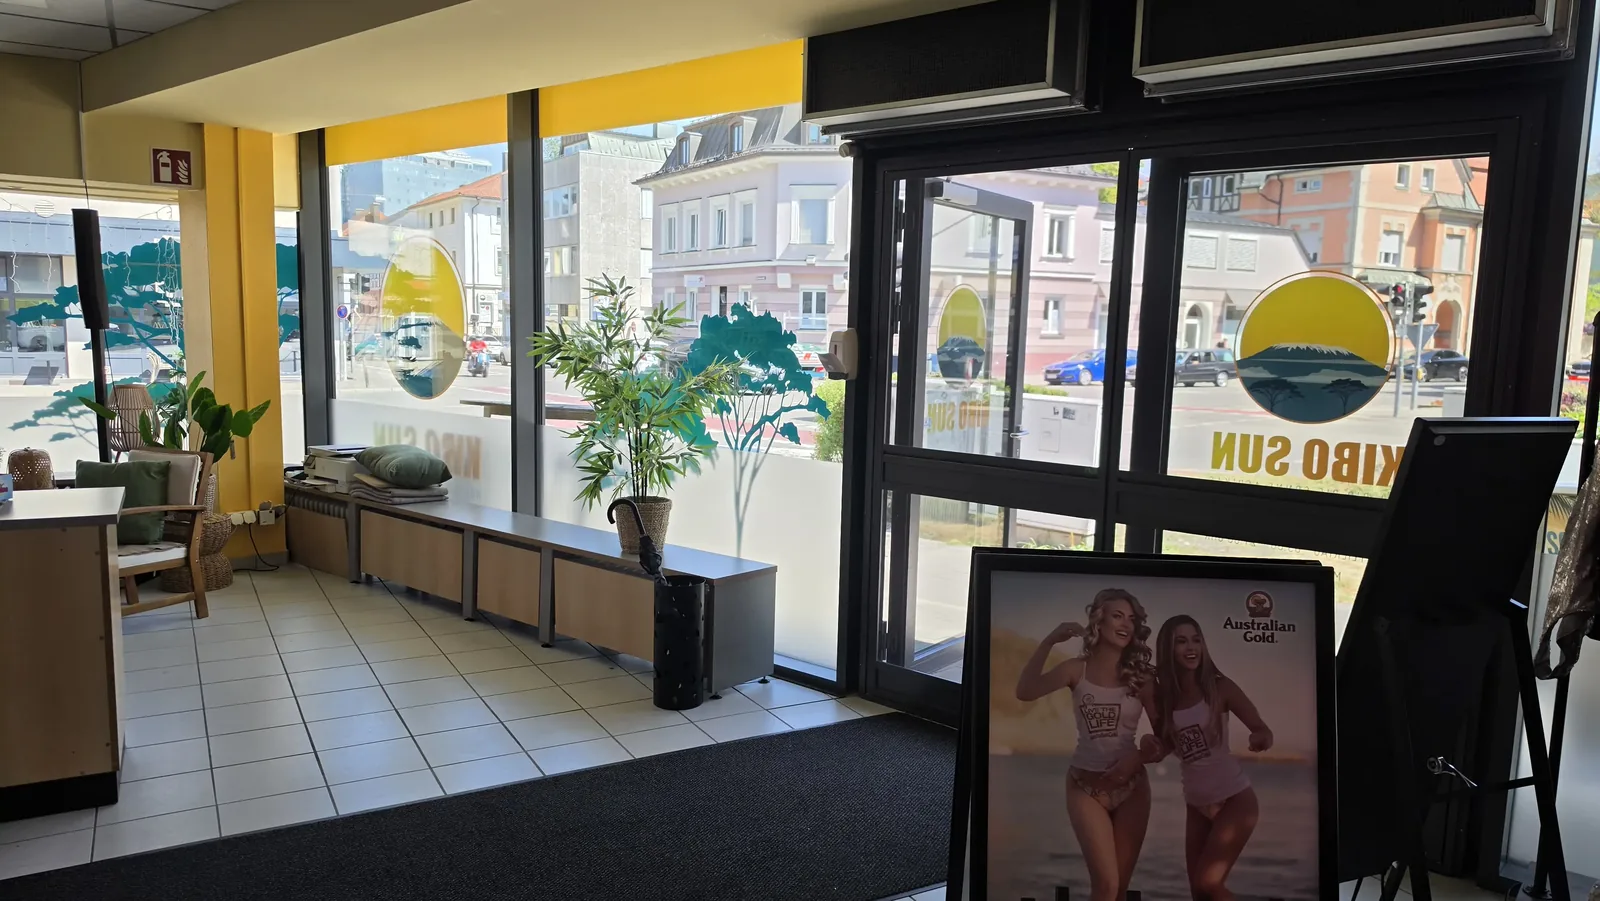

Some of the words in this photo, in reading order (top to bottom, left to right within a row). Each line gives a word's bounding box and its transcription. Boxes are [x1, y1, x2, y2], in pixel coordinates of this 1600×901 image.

[1223, 616, 1296, 632] Australian
[1243, 631, 1276, 643] Gold
[1086, 711, 1116, 720] GOLD
[1089, 719, 1115, 729] LIFE
[1181, 739, 1204, 755] LIFE
